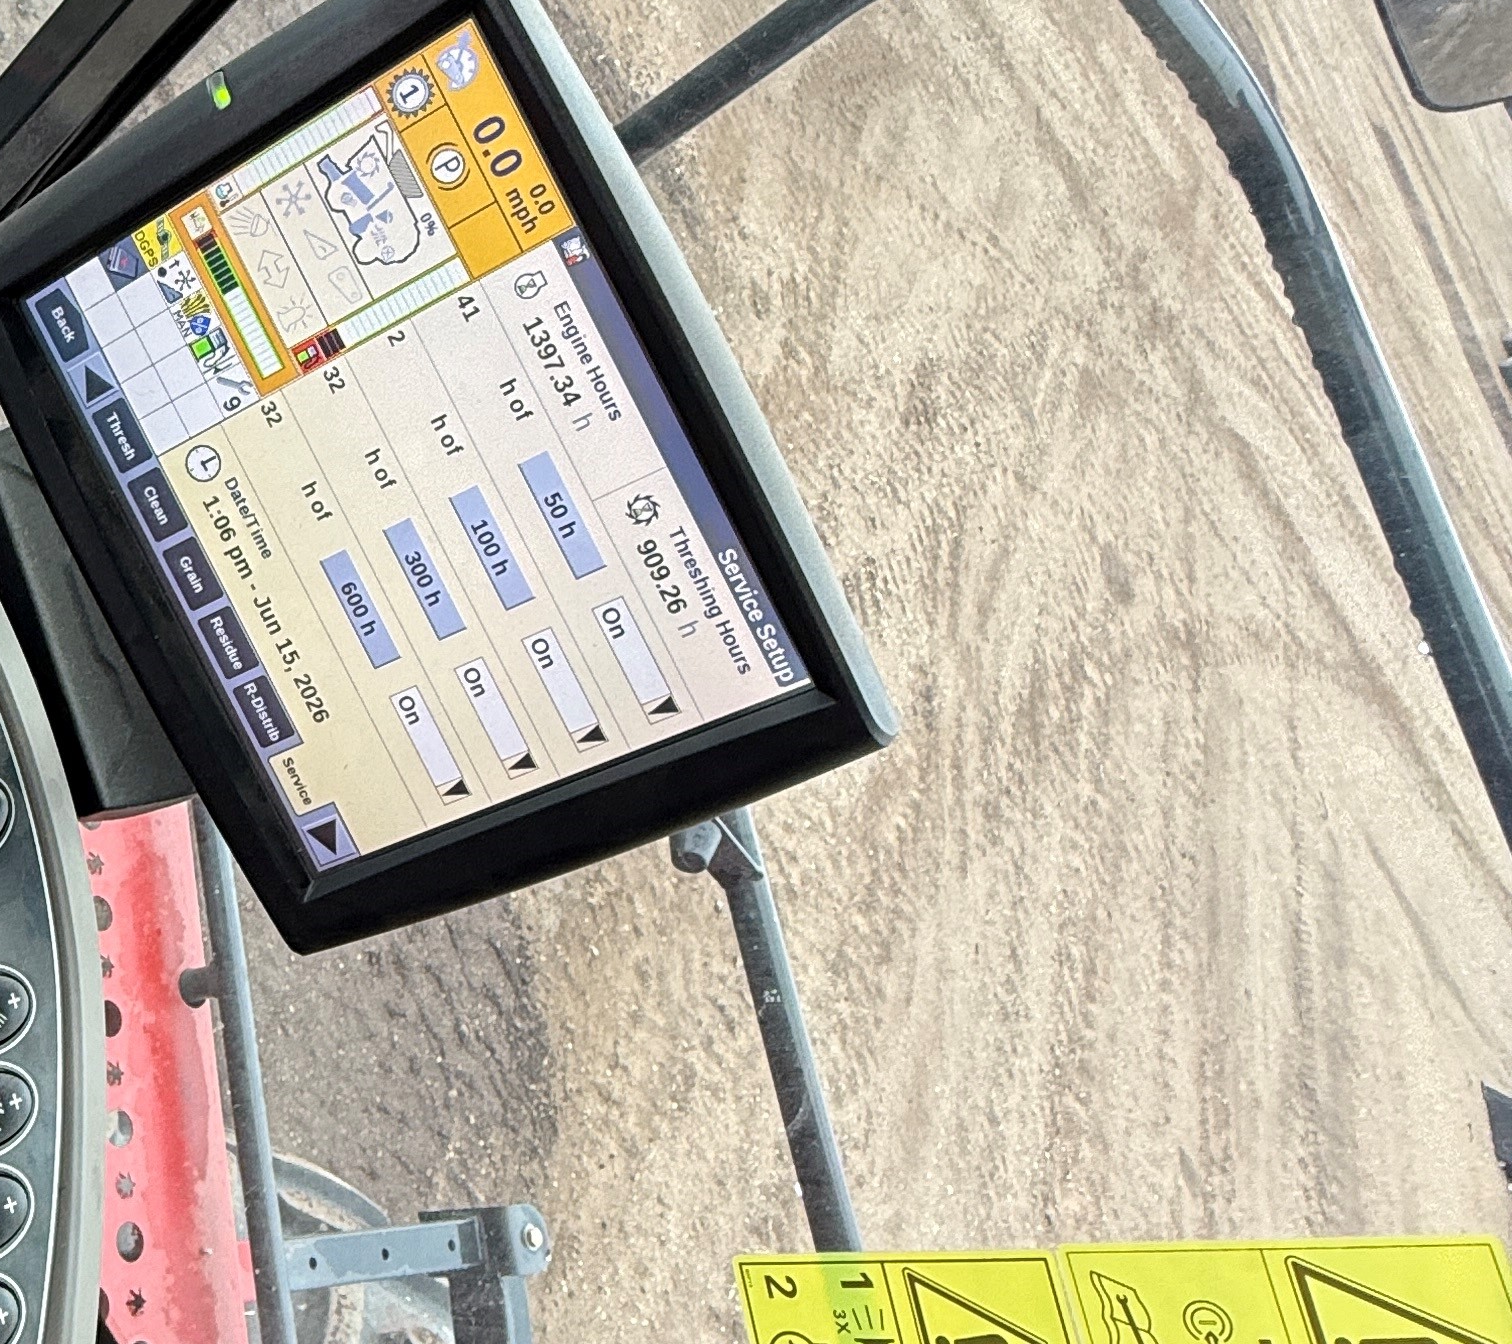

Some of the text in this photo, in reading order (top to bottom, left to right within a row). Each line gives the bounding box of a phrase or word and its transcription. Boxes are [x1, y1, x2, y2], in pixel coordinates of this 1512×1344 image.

[400, 84, 419, 104] 1
[435, 155, 461, 173] P
[473, 116, 523, 177] 0.0
[506, 188, 538, 234] mph
[529, 183, 555, 215] 0.0
[420, 212, 438, 236] 0%
[134, 230, 158, 268] DGPS
[51, 306, 76, 344] Back
[172, 310, 192, 338] MAN
[523, 316, 593, 432] 1397.34 h
[553, 300, 622, 422] Engine Hours
[223, 397, 241, 411] 9
[457, 295, 577, 539] 41 h of 50 h
[106, 411, 136, 462] Thresh
[387, 330, 509, 577] 2 h of 100 h
[143, 485, 169, 526] Clean
[324, 366, 442, 608] 32 h of 300 h
[224, 476, 272, 561] Date/Time
[261, 401, 377, 637] 32 h of 600 h
[179, 555, 205, 594] Grain
[637, 539, 699, 639] 909.26 h
[202, 495, 330, 724] 1:06 pm - Jun 15, 2026
[602, 607, 626, 640] On
[669, 525, 751, 676] Threshing Hours
[718, 548, 795, 683] Service Setup
[210, 615, 243, 671] Residue
[531, 638, 555, 670] On
[463, 667, 486, 698] On
[244, 681, 280, 743] R-Distrib
[398, 695, 420, 726] On
[282, 757, 312, 805] Service
[764, 1274, 798, 1299] 2
[840, 1272, 874, 1288] 1
